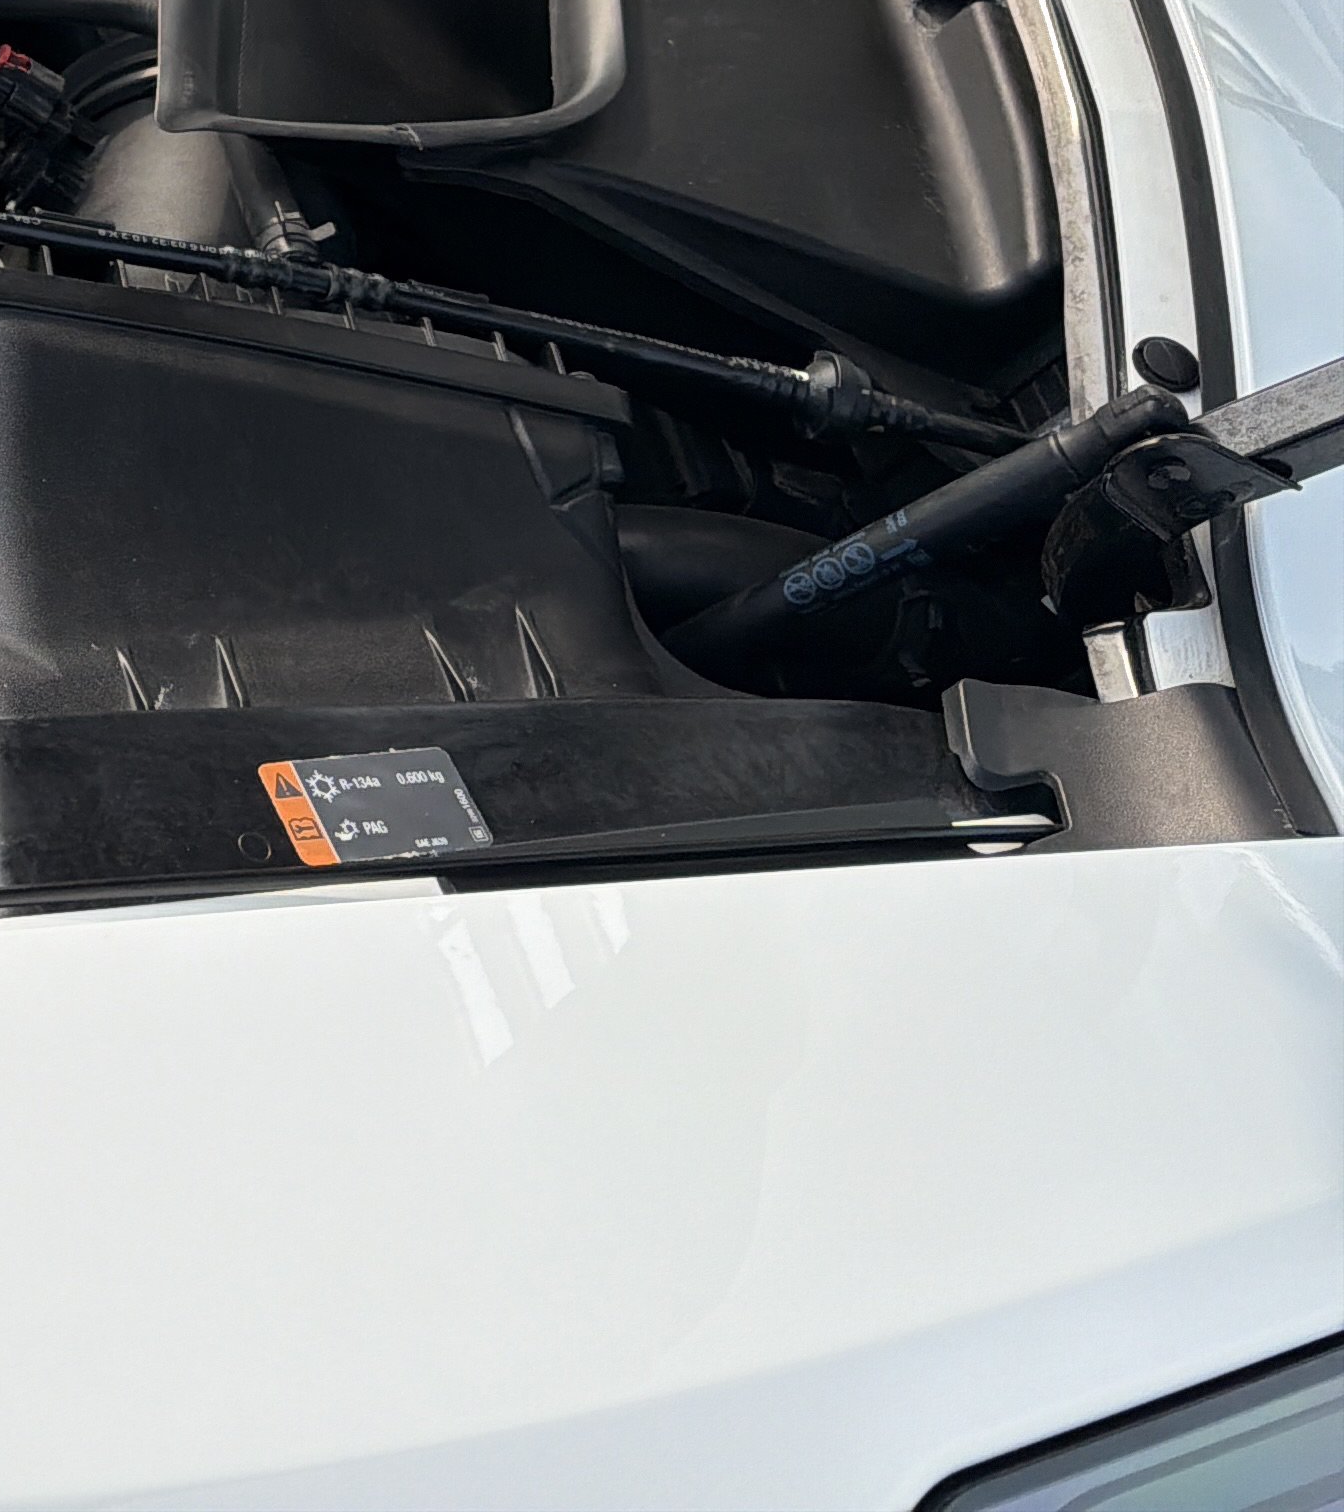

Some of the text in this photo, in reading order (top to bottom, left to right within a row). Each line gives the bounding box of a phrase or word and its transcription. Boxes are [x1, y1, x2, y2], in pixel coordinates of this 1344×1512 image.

[339, 769, 445, 791] R-134a 0.600 kg
[361, 820, 388, 836] PAG
